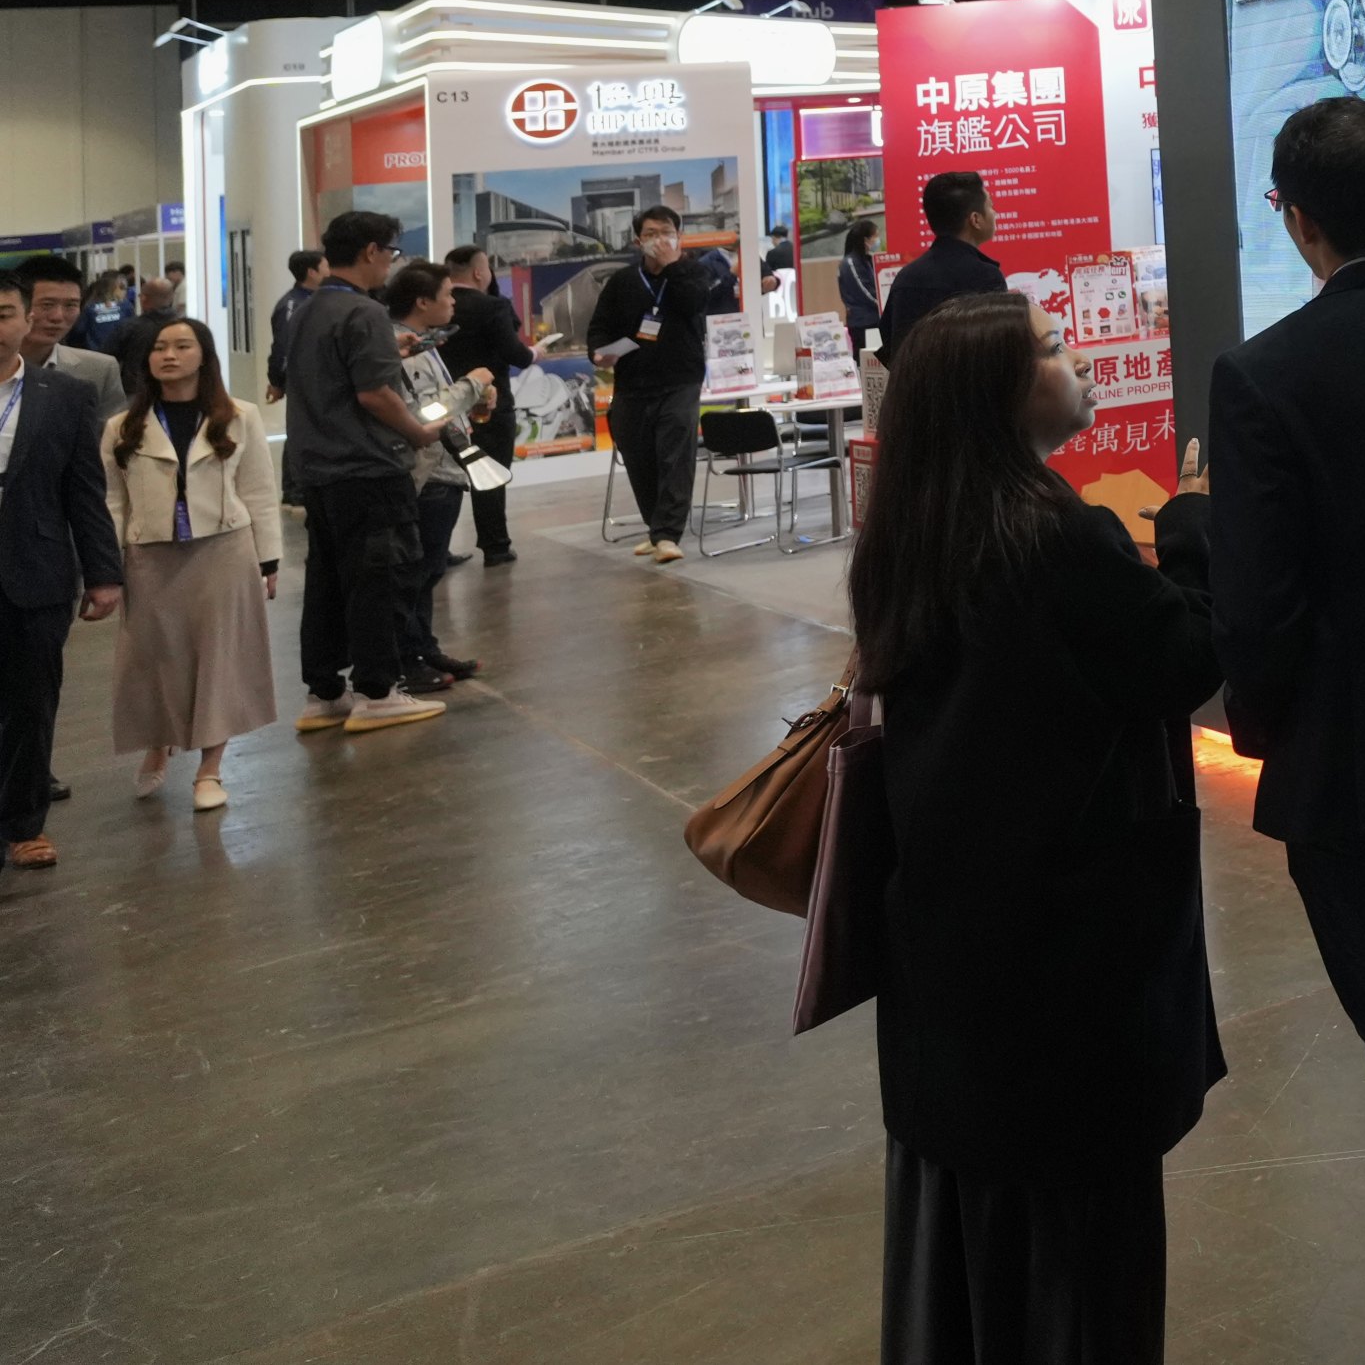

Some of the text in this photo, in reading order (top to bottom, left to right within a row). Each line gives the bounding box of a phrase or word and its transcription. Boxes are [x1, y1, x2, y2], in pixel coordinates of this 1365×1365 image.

[437, 91, 469, 103] C13
[916, 67, 1066, 115] 中原集團
[590, 110, 686, 132] HIP HING
[917, 110, 1067, 157] 旗艦公司
[384, 151, 427, 169] PRO
